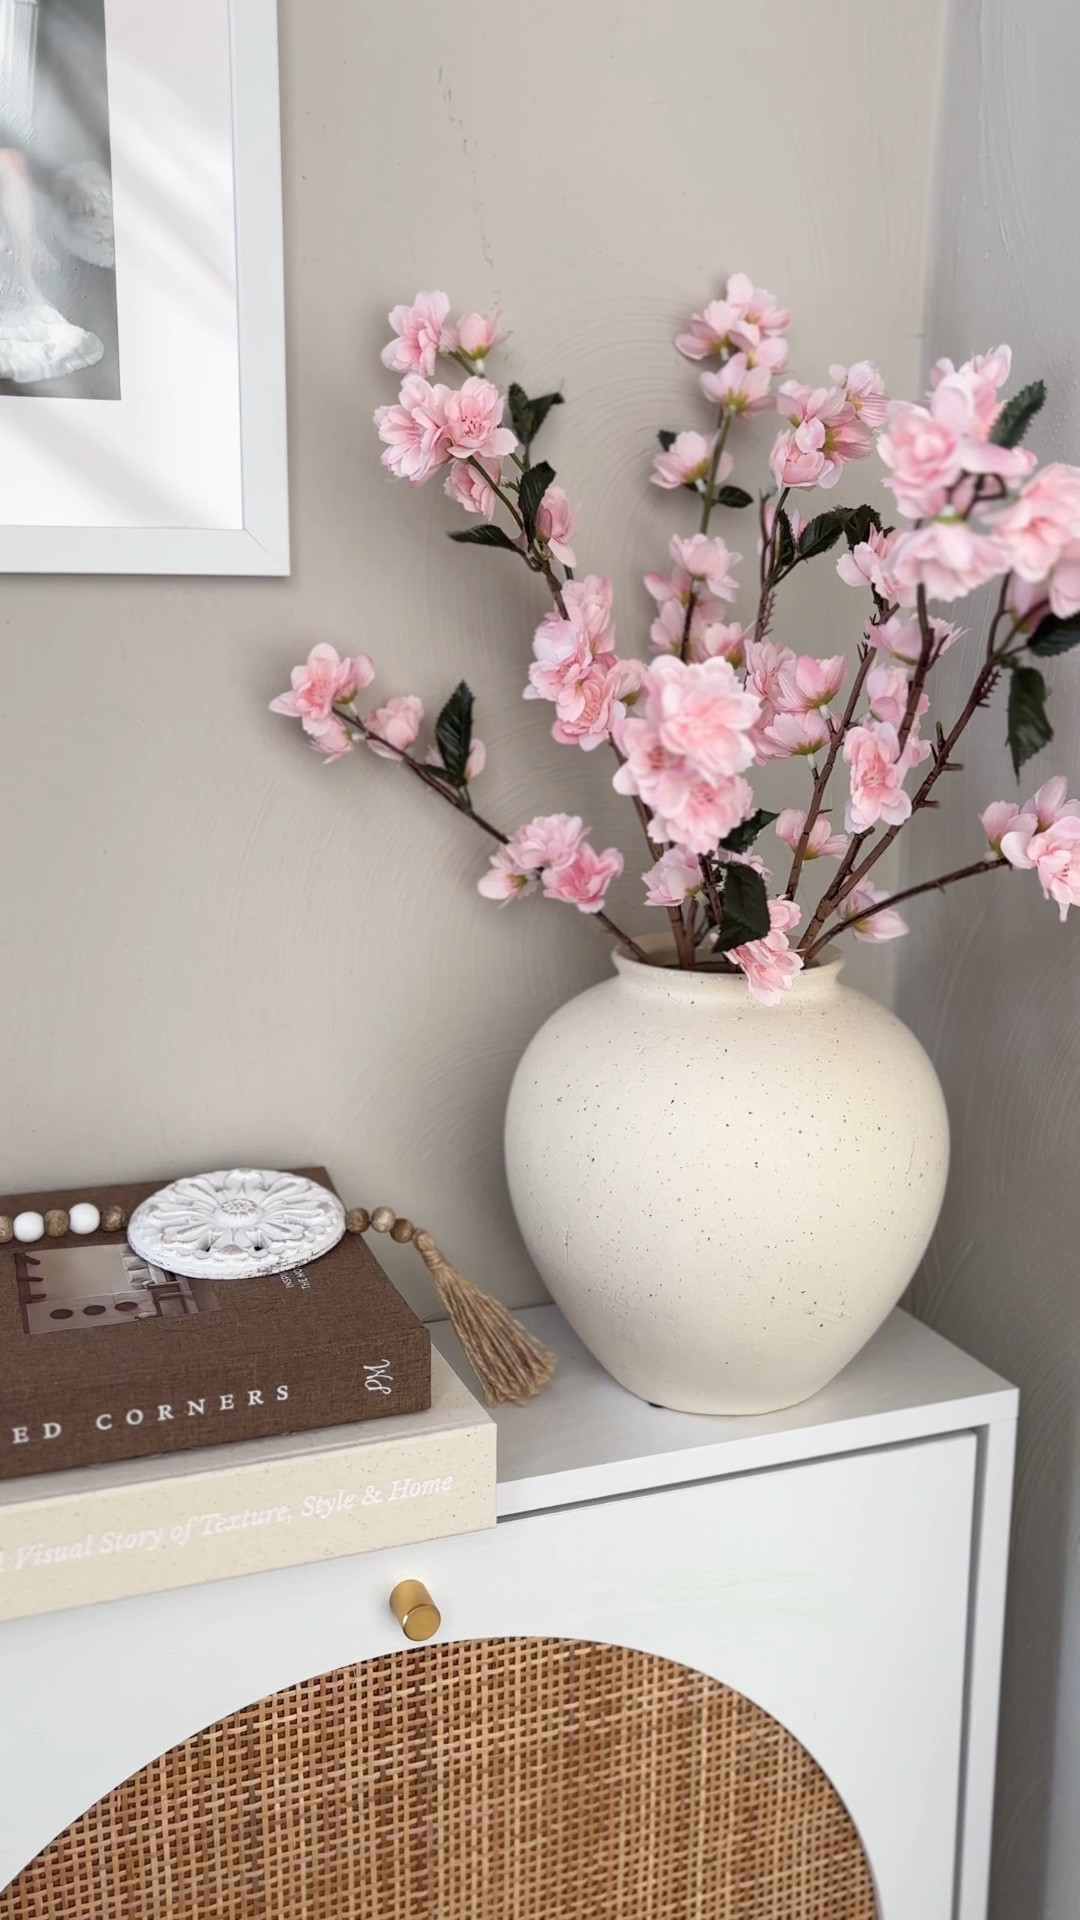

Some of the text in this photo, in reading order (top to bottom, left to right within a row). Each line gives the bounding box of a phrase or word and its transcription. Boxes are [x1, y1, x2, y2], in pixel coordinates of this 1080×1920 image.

[12, 1385, 289, 1444] ED CORNERS
[16, 1533, 92, 1570] Visual
[100, 1528, 163, 1553] Story
[170, 1515, 198, 1546] of
[201, 1507, 293, 1536] Texture,
[300, 1488, 356, 1519] Style
[362, 1484, 383, 1506] &
[388, 1475, 454, 1502] Home
